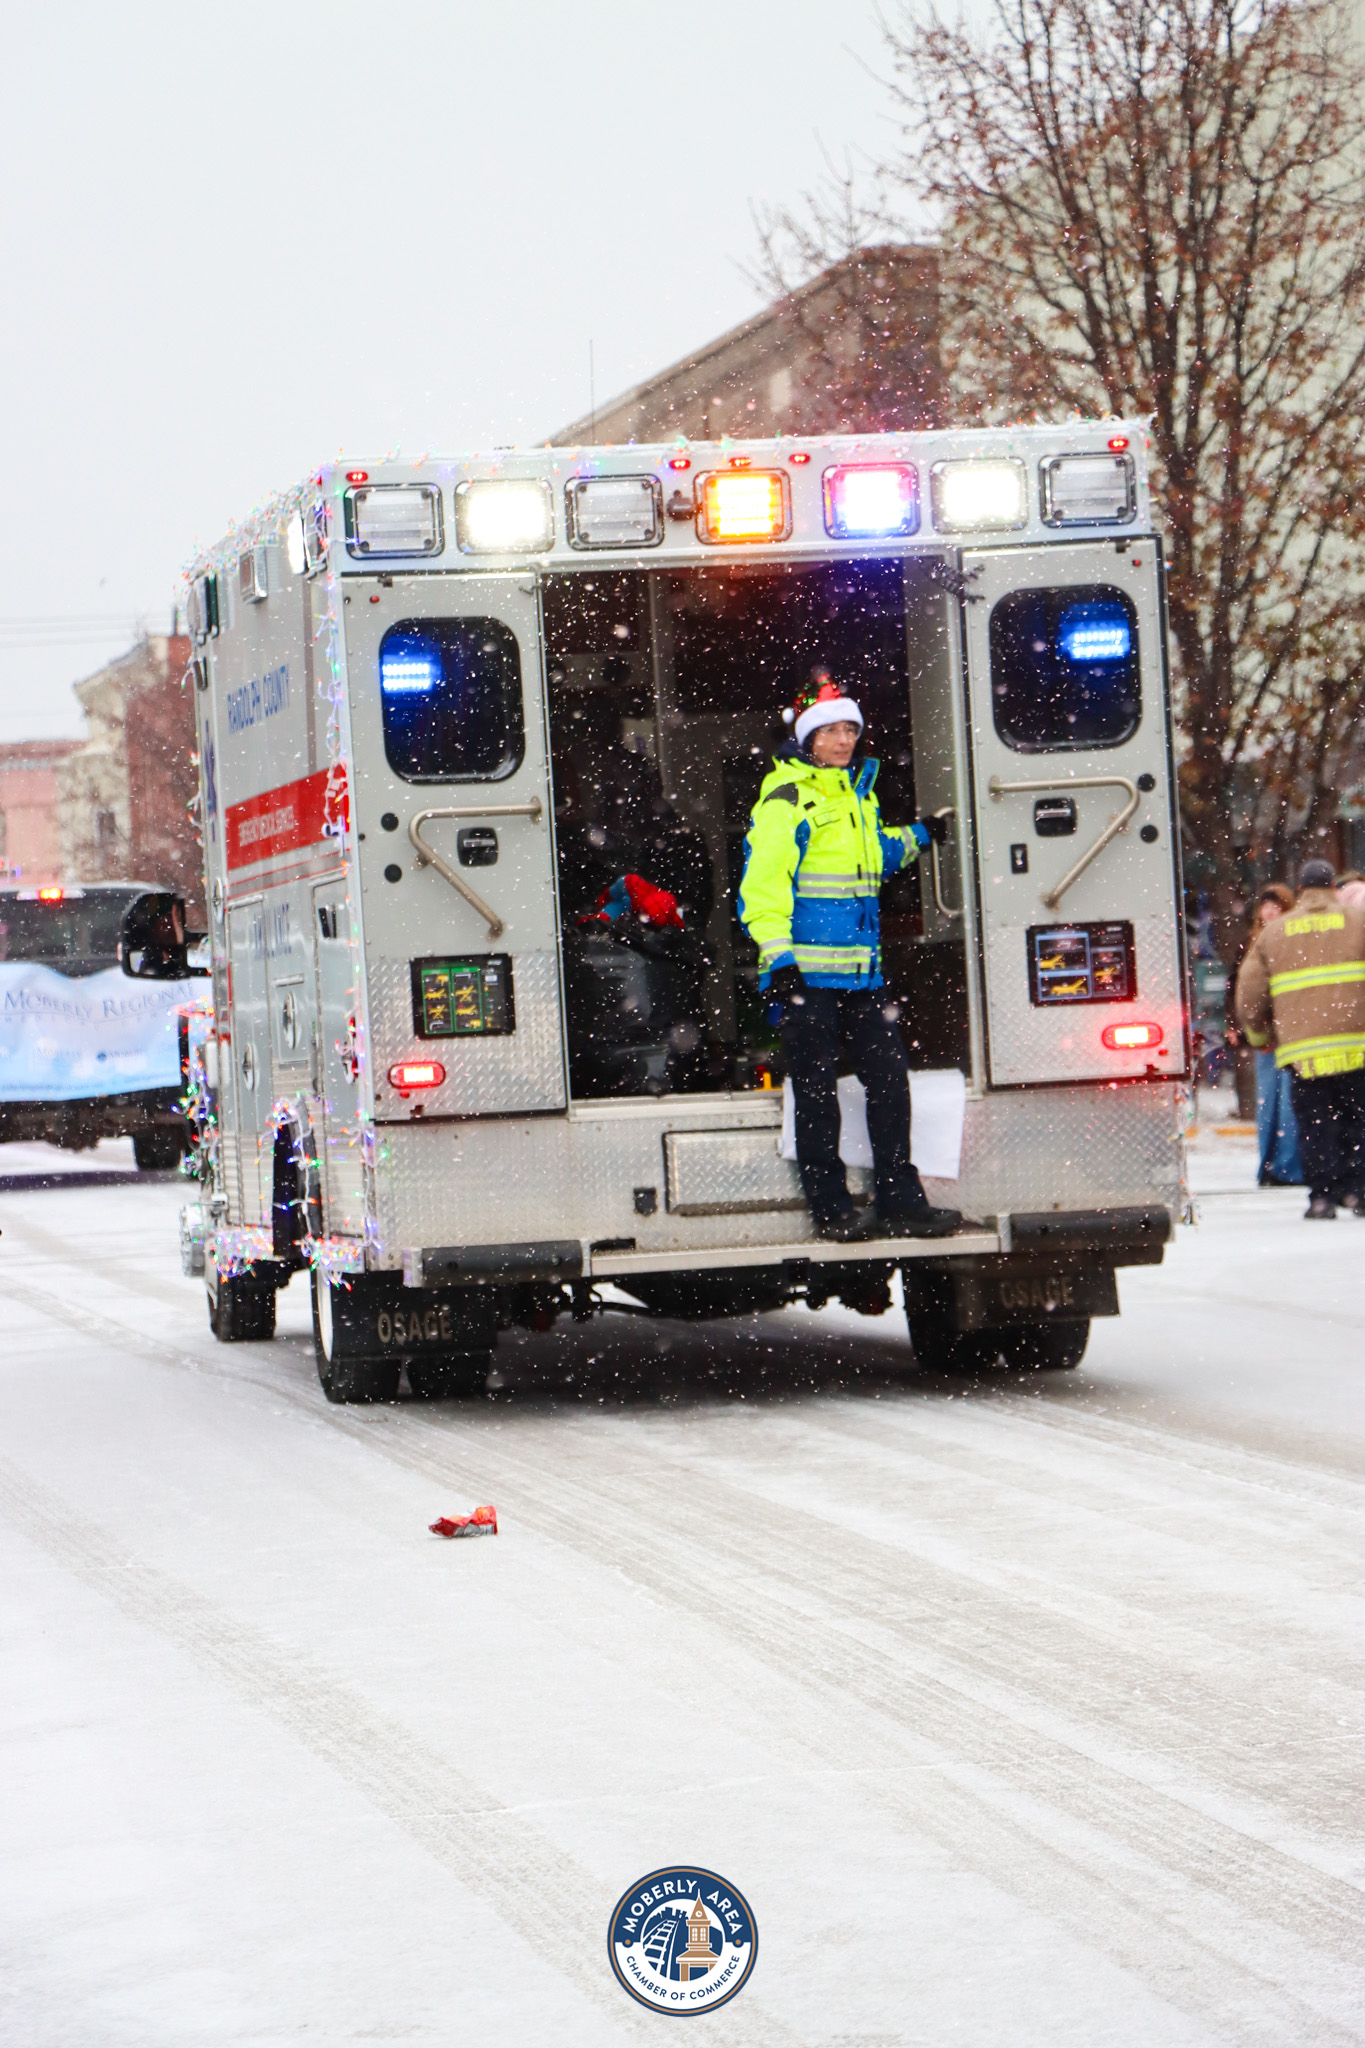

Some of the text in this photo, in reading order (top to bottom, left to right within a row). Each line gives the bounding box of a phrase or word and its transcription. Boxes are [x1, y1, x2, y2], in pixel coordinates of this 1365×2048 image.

[227, 663, 291, 735] RANDOLPH COUNTY
[1284, 912, 1345, 936] EASTERN
[4, 982, 193, 1017] MOBERLY REGIONAL
[1314, 1050, 1364, 1076] BUTLER
[999, 1276, 1075, 1310] OSAGE
[377, 1311, 452, 1344] OSAGE
